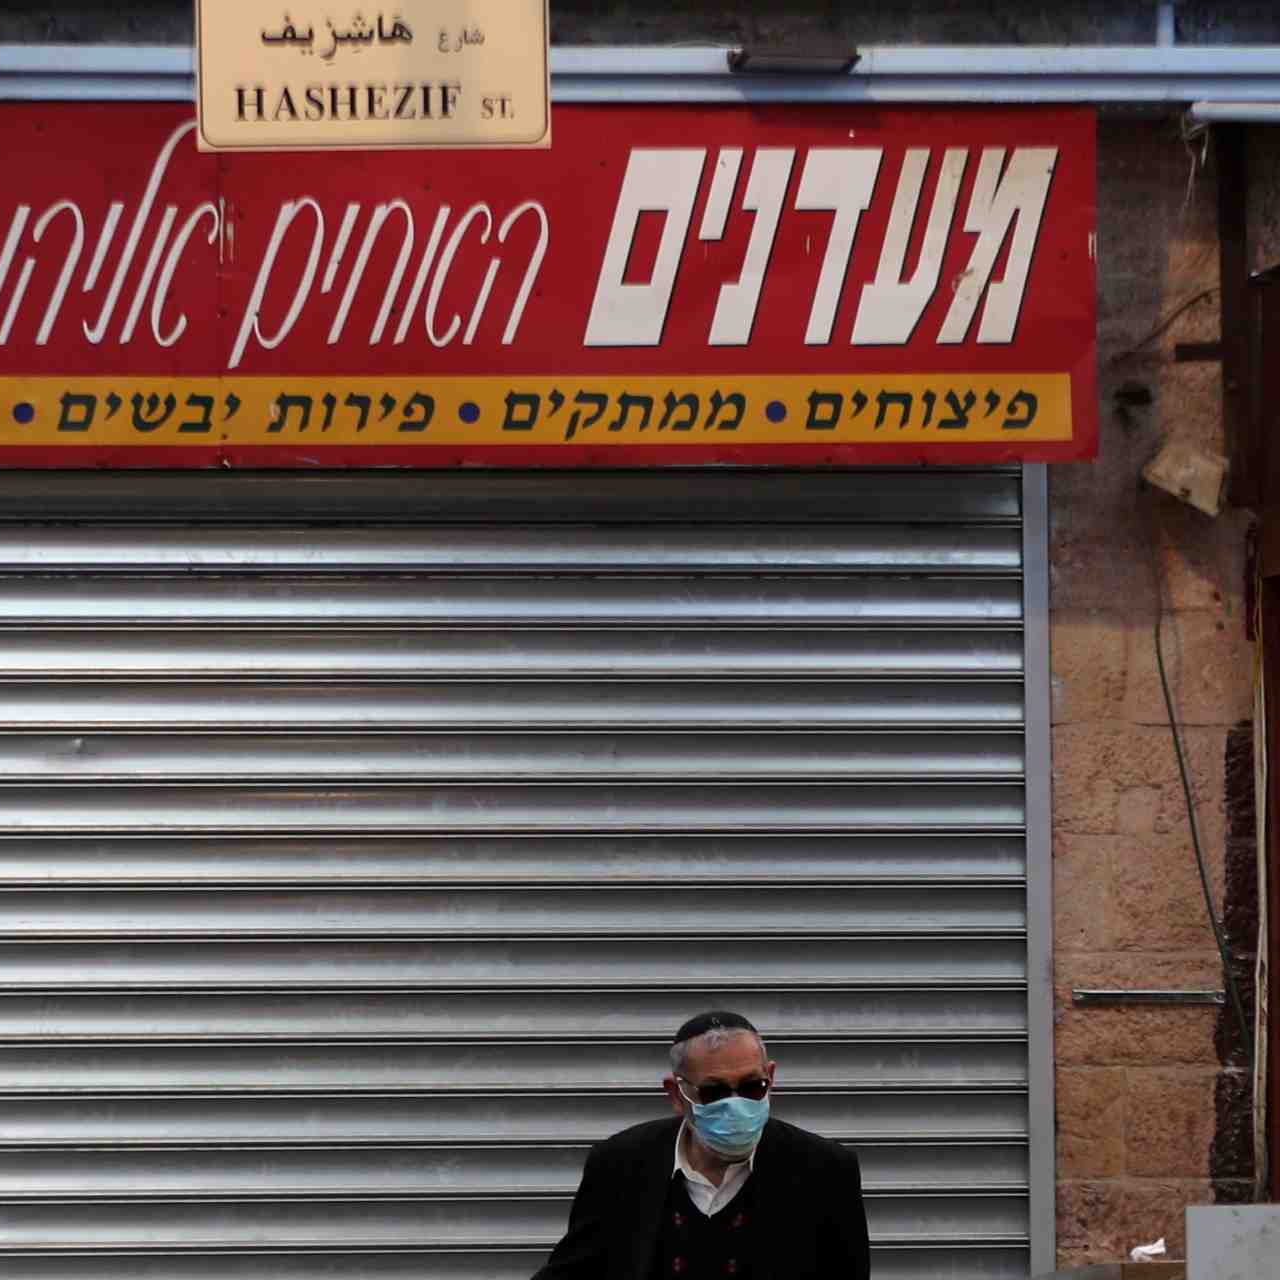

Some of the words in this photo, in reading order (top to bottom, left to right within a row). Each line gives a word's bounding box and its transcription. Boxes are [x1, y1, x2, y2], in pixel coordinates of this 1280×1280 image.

[436, 26, 486, 54] شارع
[234, 82, 462, 122] HASHEZIF
[481, 97, 515, 120] ST.
[583, 147, 1059, 346] מעדנים
[227, 196, 549, 369] האחים
[57, 391, 241, 433] יבשים
[267, 391, 435, 433] פירות
[502, 389, 747, 441] ממתקים
[805, 389, 1038, 430] פיצוחים
